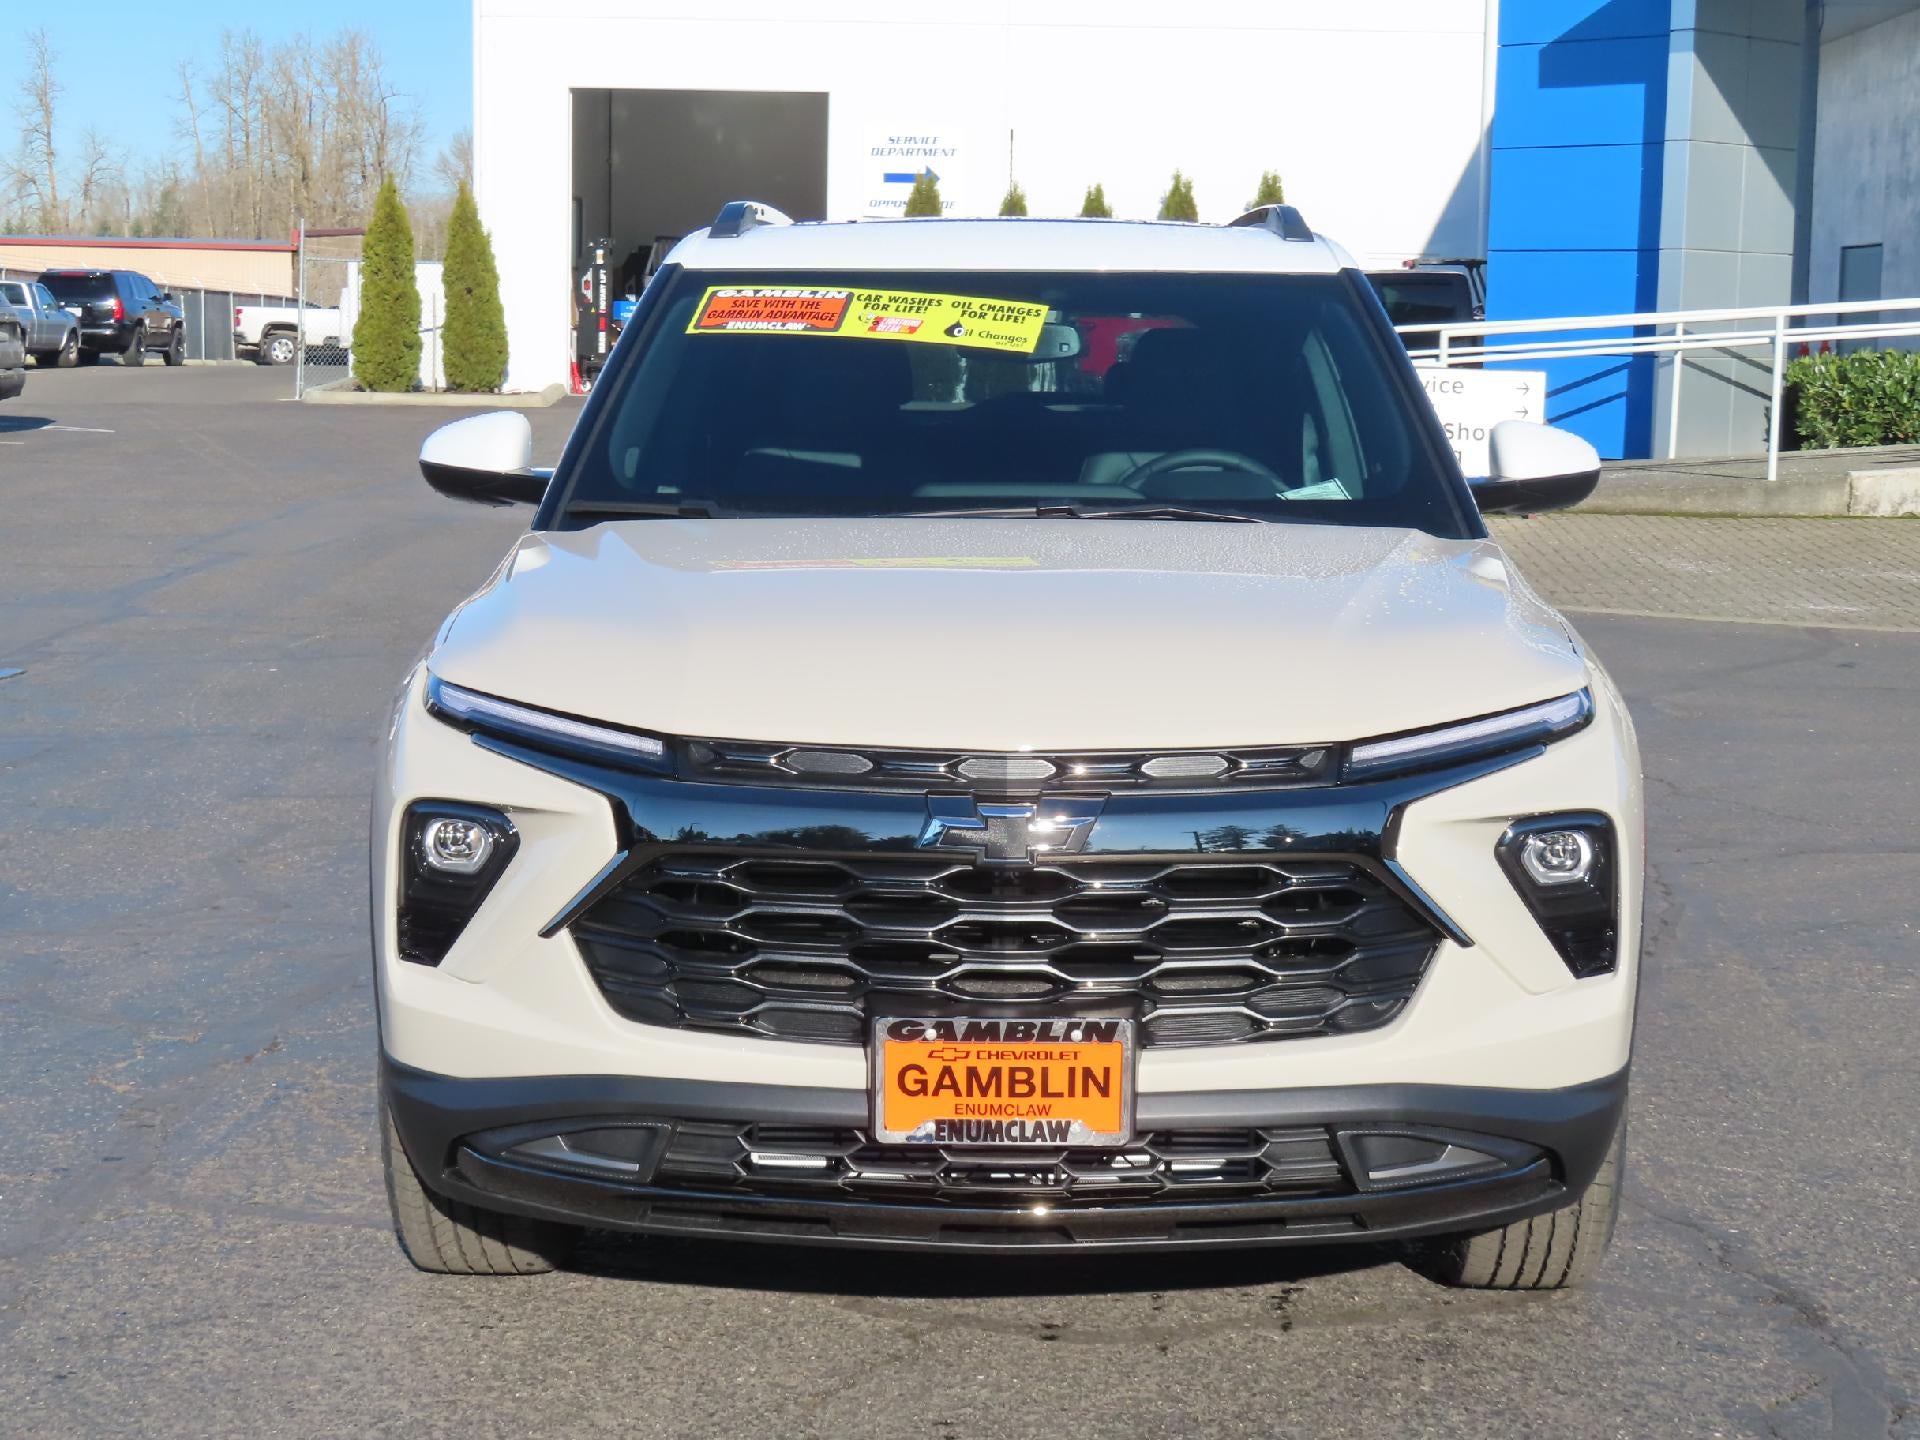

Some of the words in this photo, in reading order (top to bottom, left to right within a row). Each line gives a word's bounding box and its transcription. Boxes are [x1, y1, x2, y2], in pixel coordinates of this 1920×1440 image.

[888, 136, 941, 145] SERVICE
[871, 147, 958, 157] DEPARTMENT
[716, 289, 849, 299] GAMBLIN
[856, 293, 884, 302] CAR
[888, 295, 943, 307] WASHES
[731, 299, 760, 308] SAVE
[763, 299, 796, 309] WITH
[799, 300, 822, 310] THE
[863, 302, 890, 311] FOR
[894, 305, 928, 314] LIFE!
[951, 300, 973, 309] OIL
[979, 303, 1042, 317] CHANGES
[707, 310, 763, 319] GAMBLIN
[765, 310, 838, 321] ADVANTAGE
[960, 309, 988, 319] FOR
[992, 313, 1026, 324] LIFE!
[978, 330, 1028, 343] Changes
[1423, 376, 1465, 394] vice
[1444, 422, 1485, 441] Sho
[886, 1019, 1120, 1043] GAMBLIN
[976, 1050, 1081, 1061] CHEVROLET
[897, 1063, 1111, 1098] GAMBLIN
[954, 1103, 1053, 1117] ENUMCLAW
[934, 1119, 1072, 1143] ENUMCLAW
